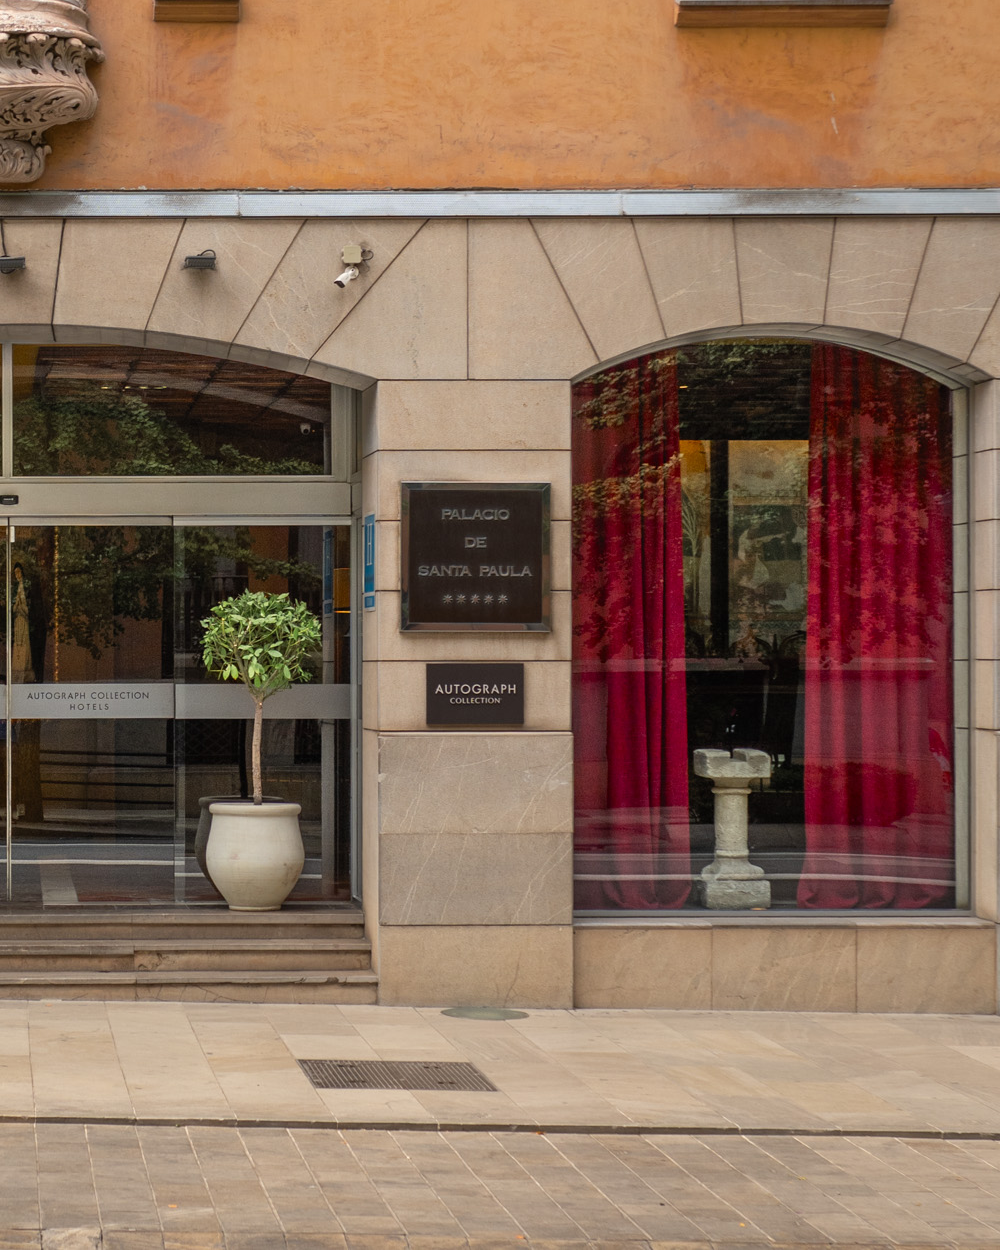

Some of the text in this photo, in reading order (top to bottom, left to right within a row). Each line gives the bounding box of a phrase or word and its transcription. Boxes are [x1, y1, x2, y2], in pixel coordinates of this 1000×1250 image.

[441, 509, 510, 520] PALACIO
[464, 537, 487, 548] DE
[418, 565, 532, 576] SANTA PAULA
[435, 684, 516, 694] AUTOGRAPH
[27, 691, 150, 700] AUTOGRAPH COLLECTION
[449, 697, 501, 705] COLLECTION
[69, 703, 110, 711] HOTELS
